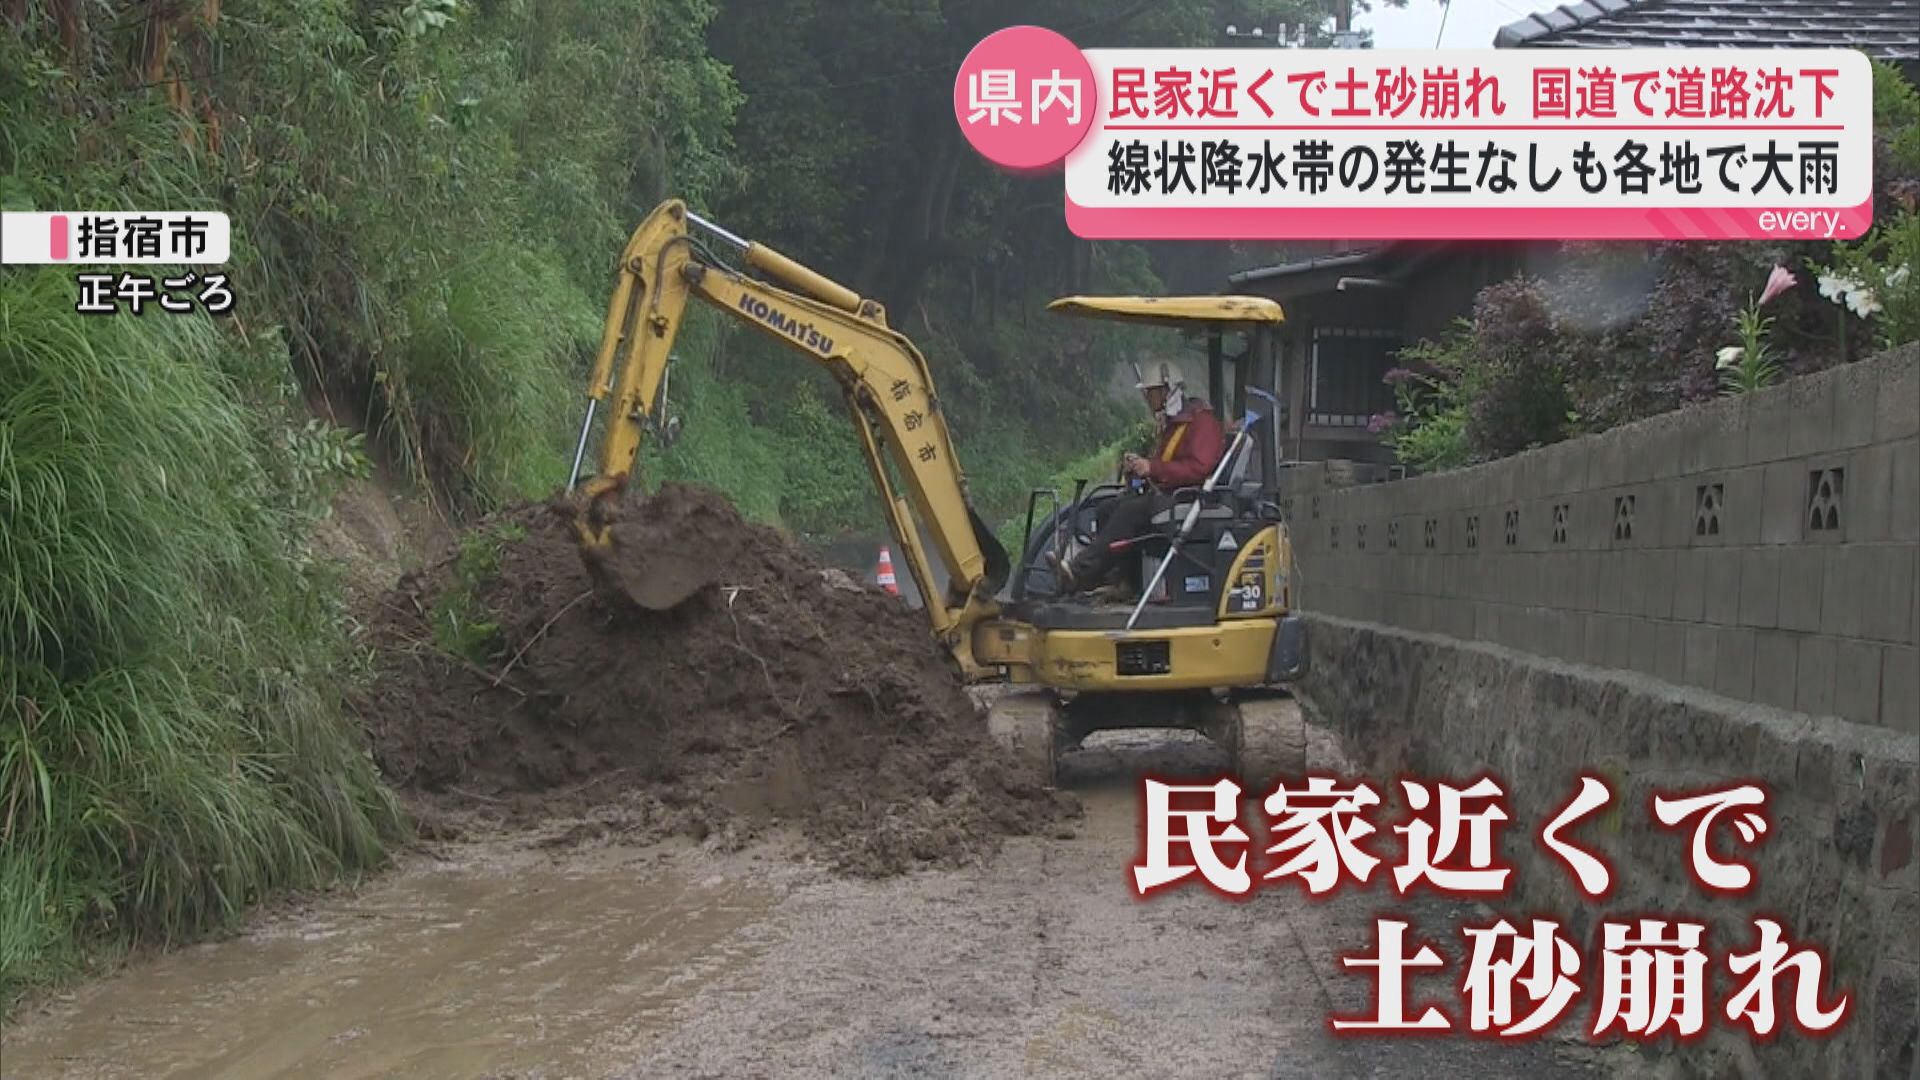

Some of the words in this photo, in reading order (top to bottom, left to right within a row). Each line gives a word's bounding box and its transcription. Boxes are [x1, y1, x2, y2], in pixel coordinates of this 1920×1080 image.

[739, 292, 834, 355] KOMATSU
[889, 378, 937, 463] 指宿市
[1241, 585, 1261, 600] 30
